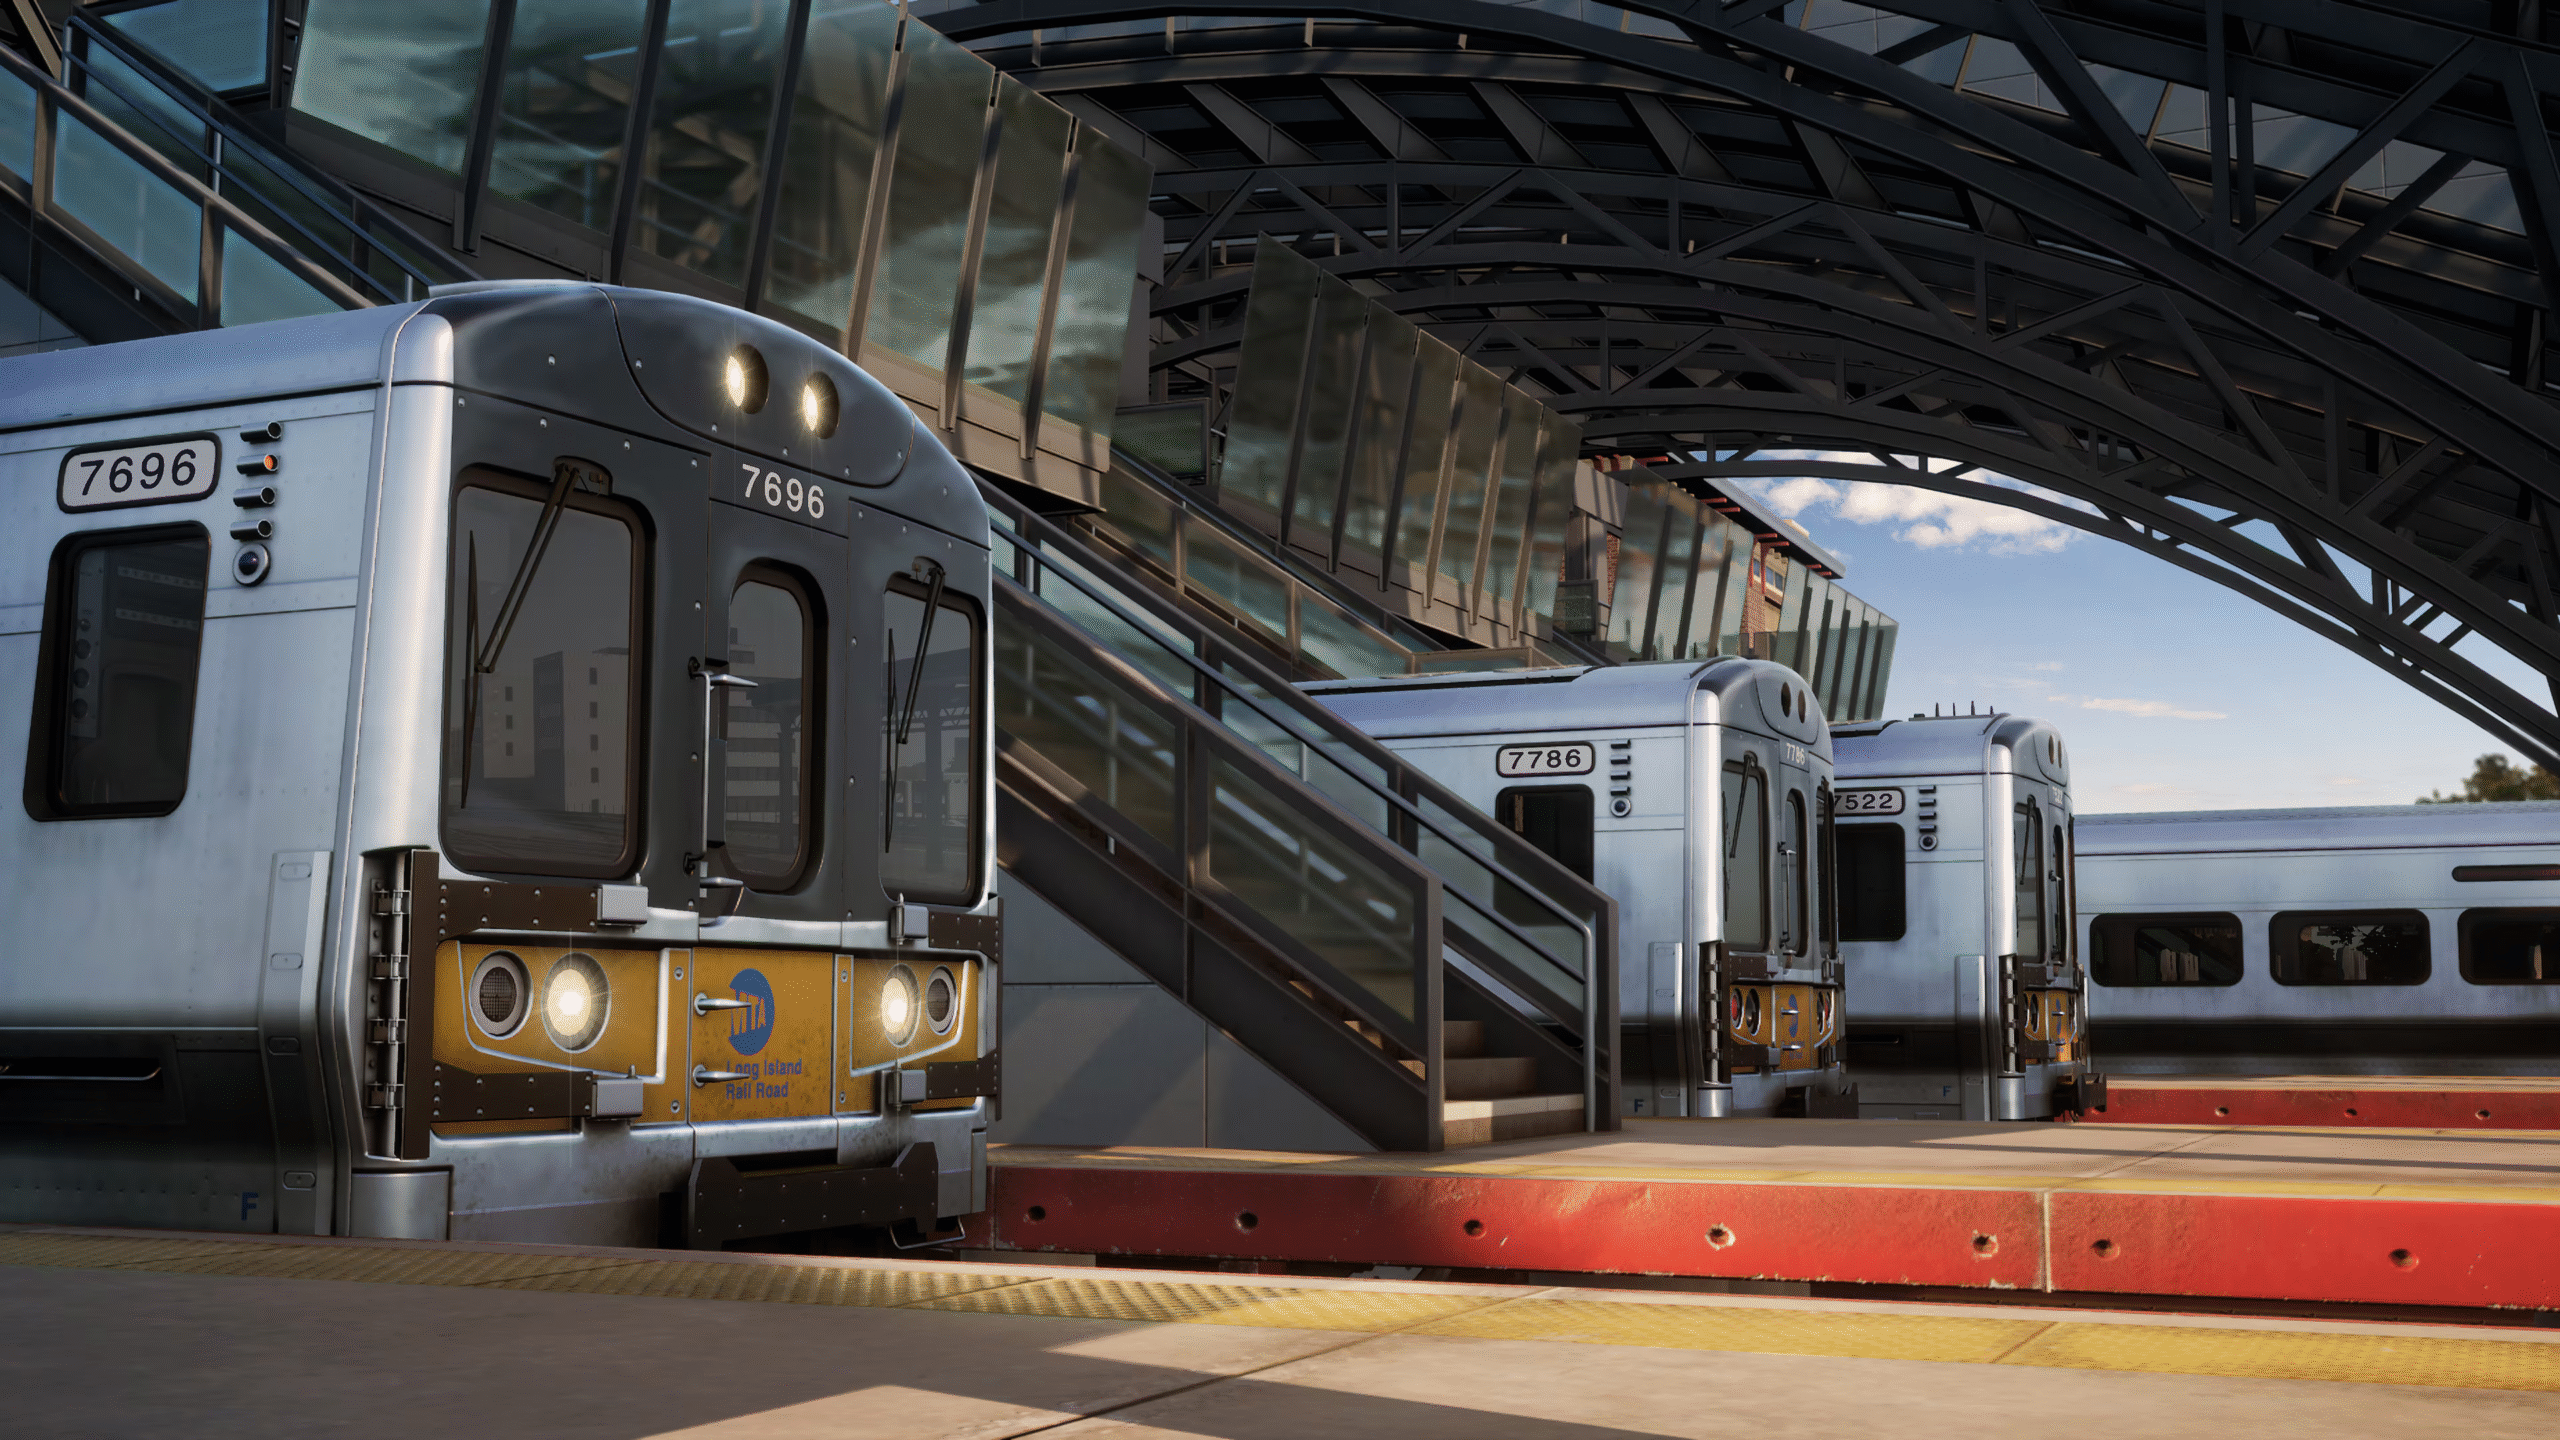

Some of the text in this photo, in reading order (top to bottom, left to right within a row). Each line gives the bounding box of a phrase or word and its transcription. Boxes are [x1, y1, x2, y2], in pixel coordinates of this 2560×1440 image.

[80, 448, 197, 496] 7696
[742, 463, 825, 519] 7696
[1508, 748, 1582, 770] 7786
[763, 1057, 803, 1076] Island
[725, 1080, 789, 1100] Rail Road
[1634, 1098, 1644, 1112] F
[241, 1191, 259, 1221] F
